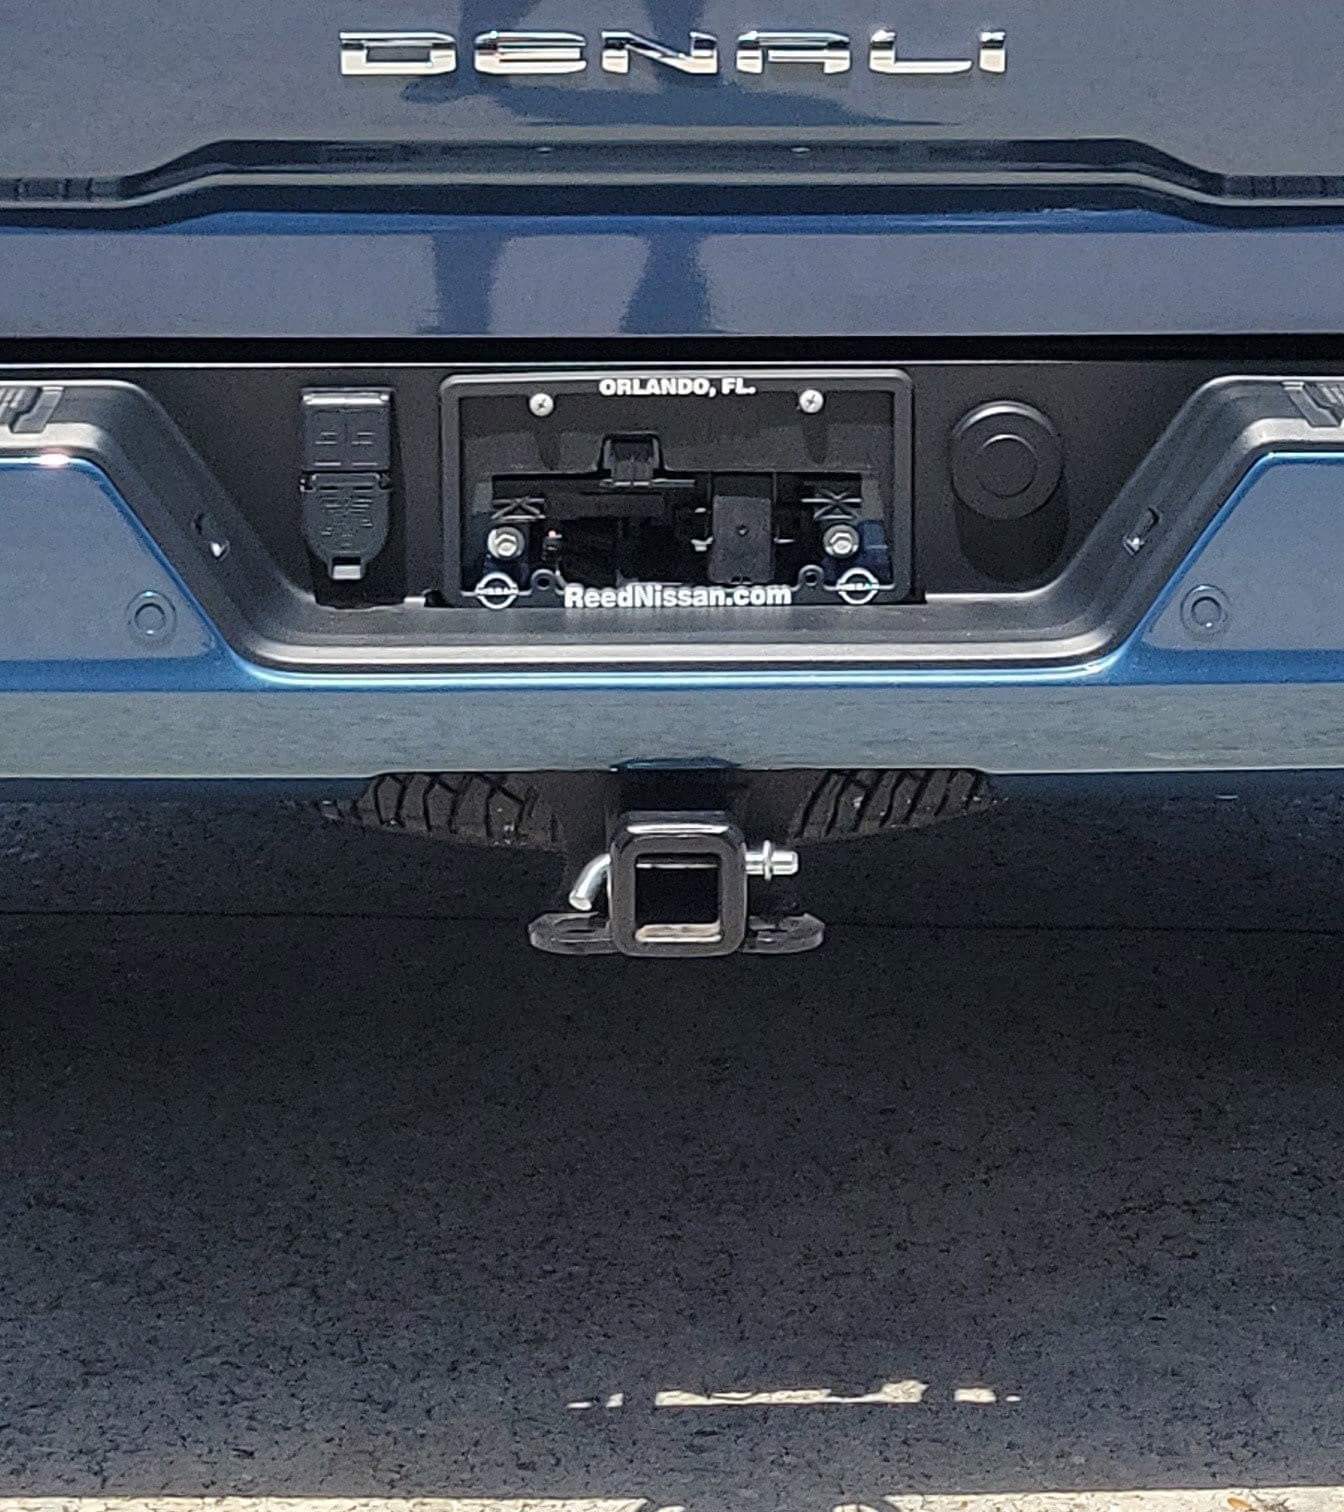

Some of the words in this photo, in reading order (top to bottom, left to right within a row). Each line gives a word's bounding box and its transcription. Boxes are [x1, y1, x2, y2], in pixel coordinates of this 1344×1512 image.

[338, 28, 1007, 77] DENALI
[598, 377, 717, 398] ORLANDO,
[720, 377, 756, 395] FL.
[563, 583, 792, 608] ReedNissan.com
